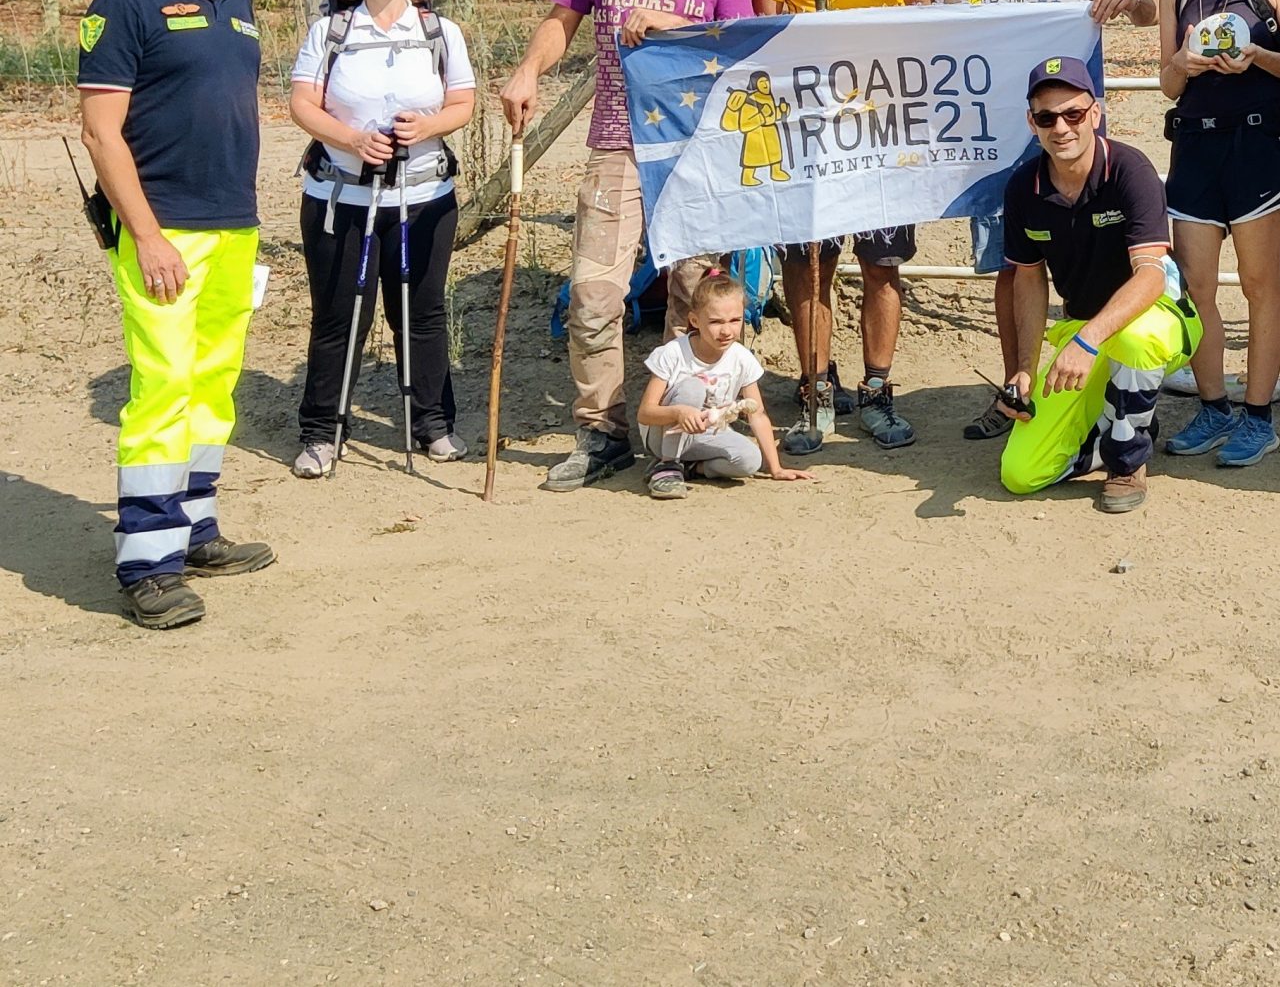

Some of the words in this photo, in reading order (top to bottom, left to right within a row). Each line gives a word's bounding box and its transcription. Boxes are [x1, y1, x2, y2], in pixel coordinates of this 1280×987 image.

[793, 54, 992, 109] ROAD20
[799, 100, 997, 157] ROME21
[803, 153, 887, 179] TWENTY
[928, 147, 999, 163] YEARS
